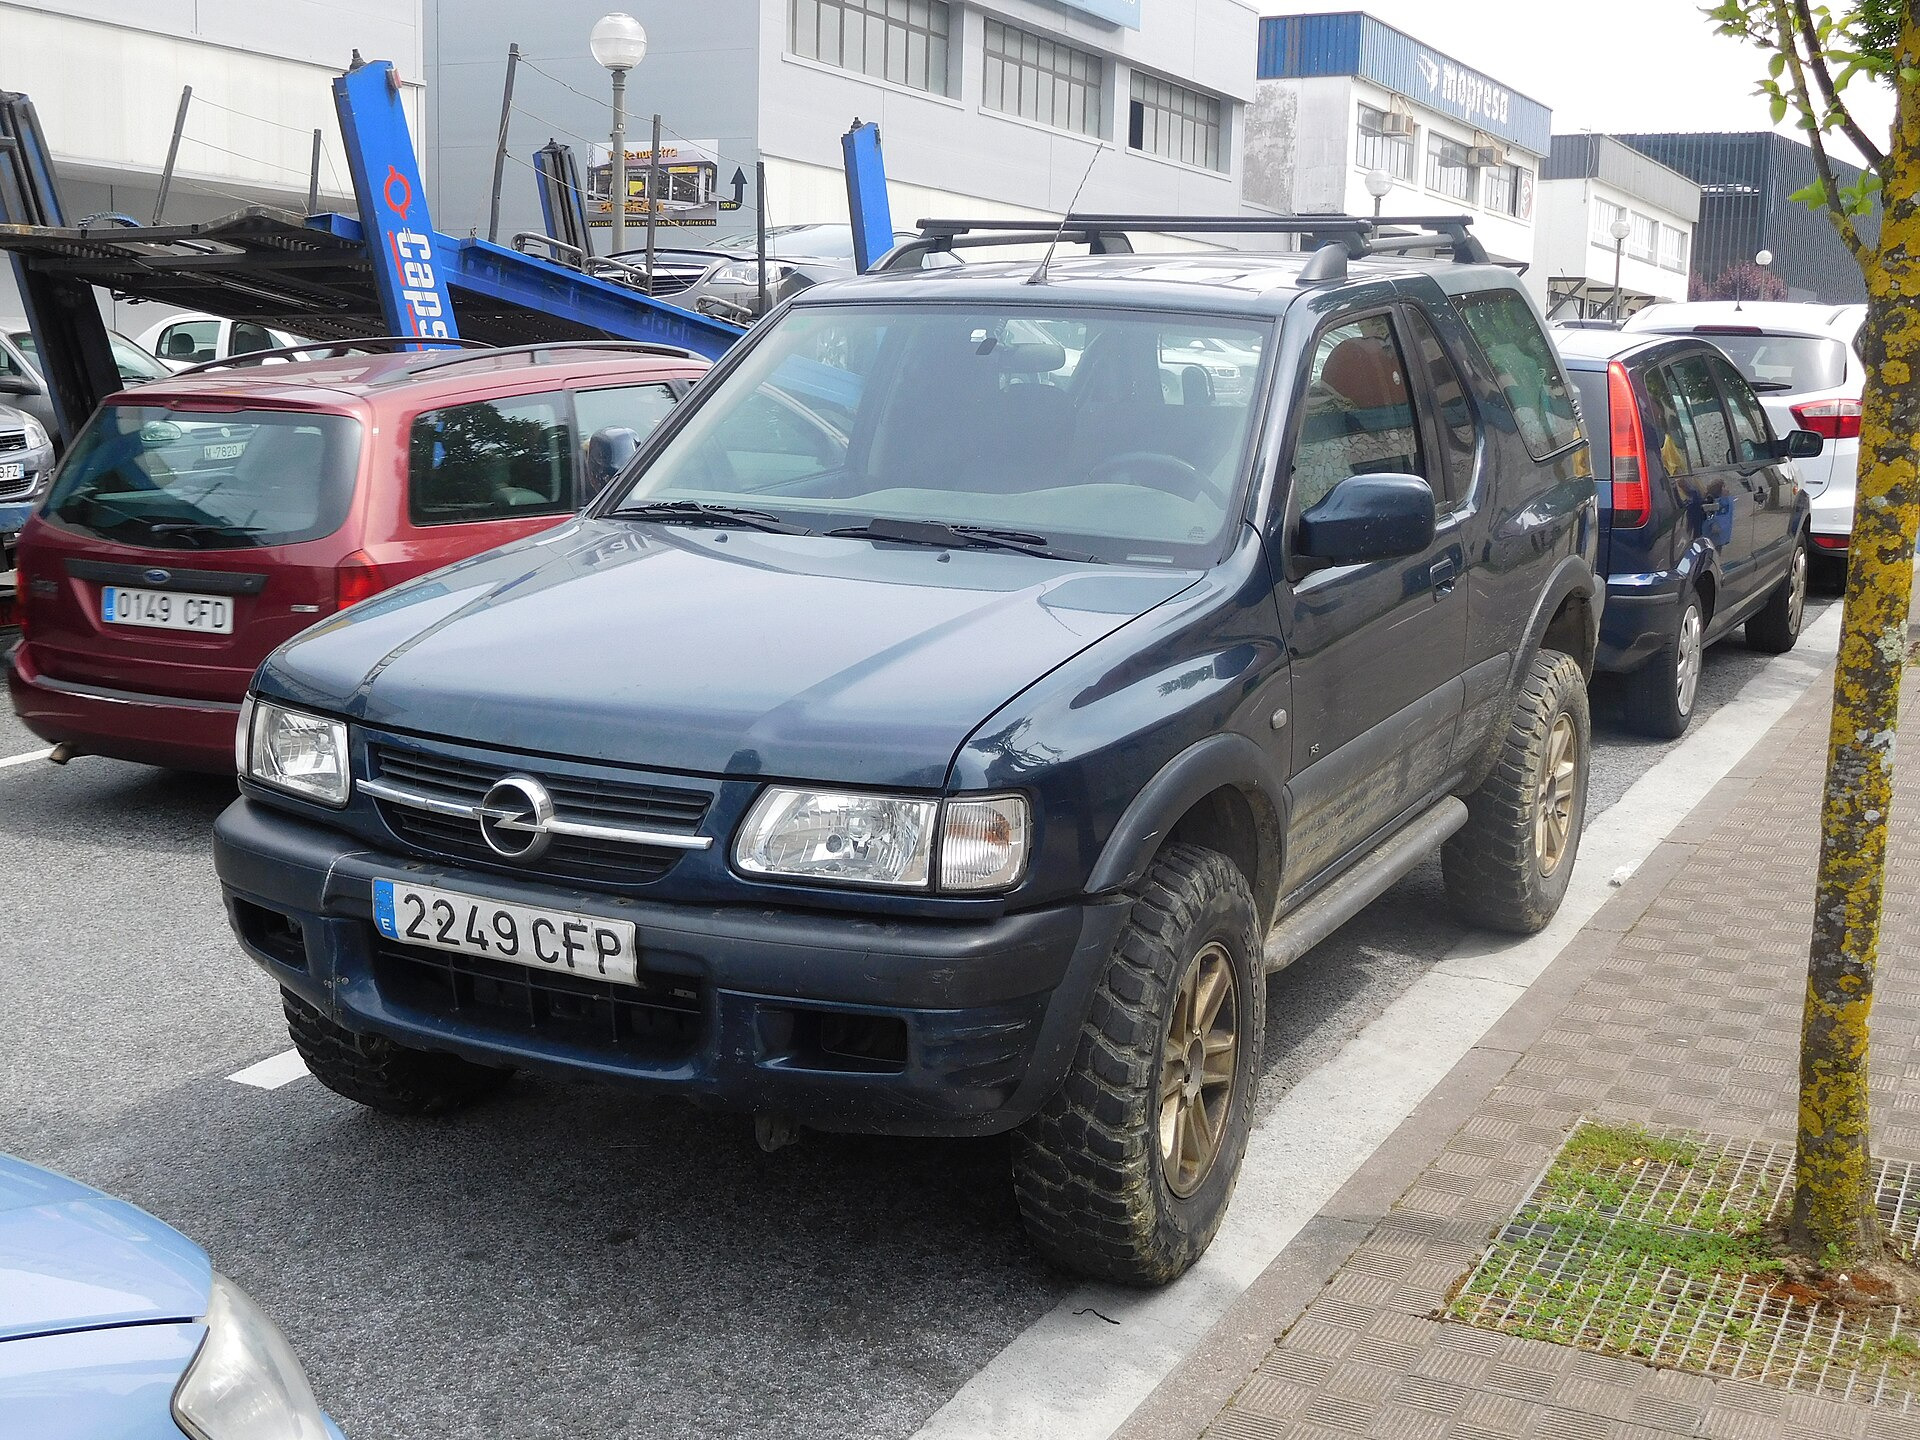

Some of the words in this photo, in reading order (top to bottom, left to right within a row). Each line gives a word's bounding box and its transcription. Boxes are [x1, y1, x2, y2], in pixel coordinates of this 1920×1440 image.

[397, 227, 449, 351] Caps
[118, 591, 171, 622] 0149
[184, 598, 226, 628] CFD
[380, 918, 392, 931] E
[404, 893, 520, 956] 2249
[532, 917, 622, 975] CFP
